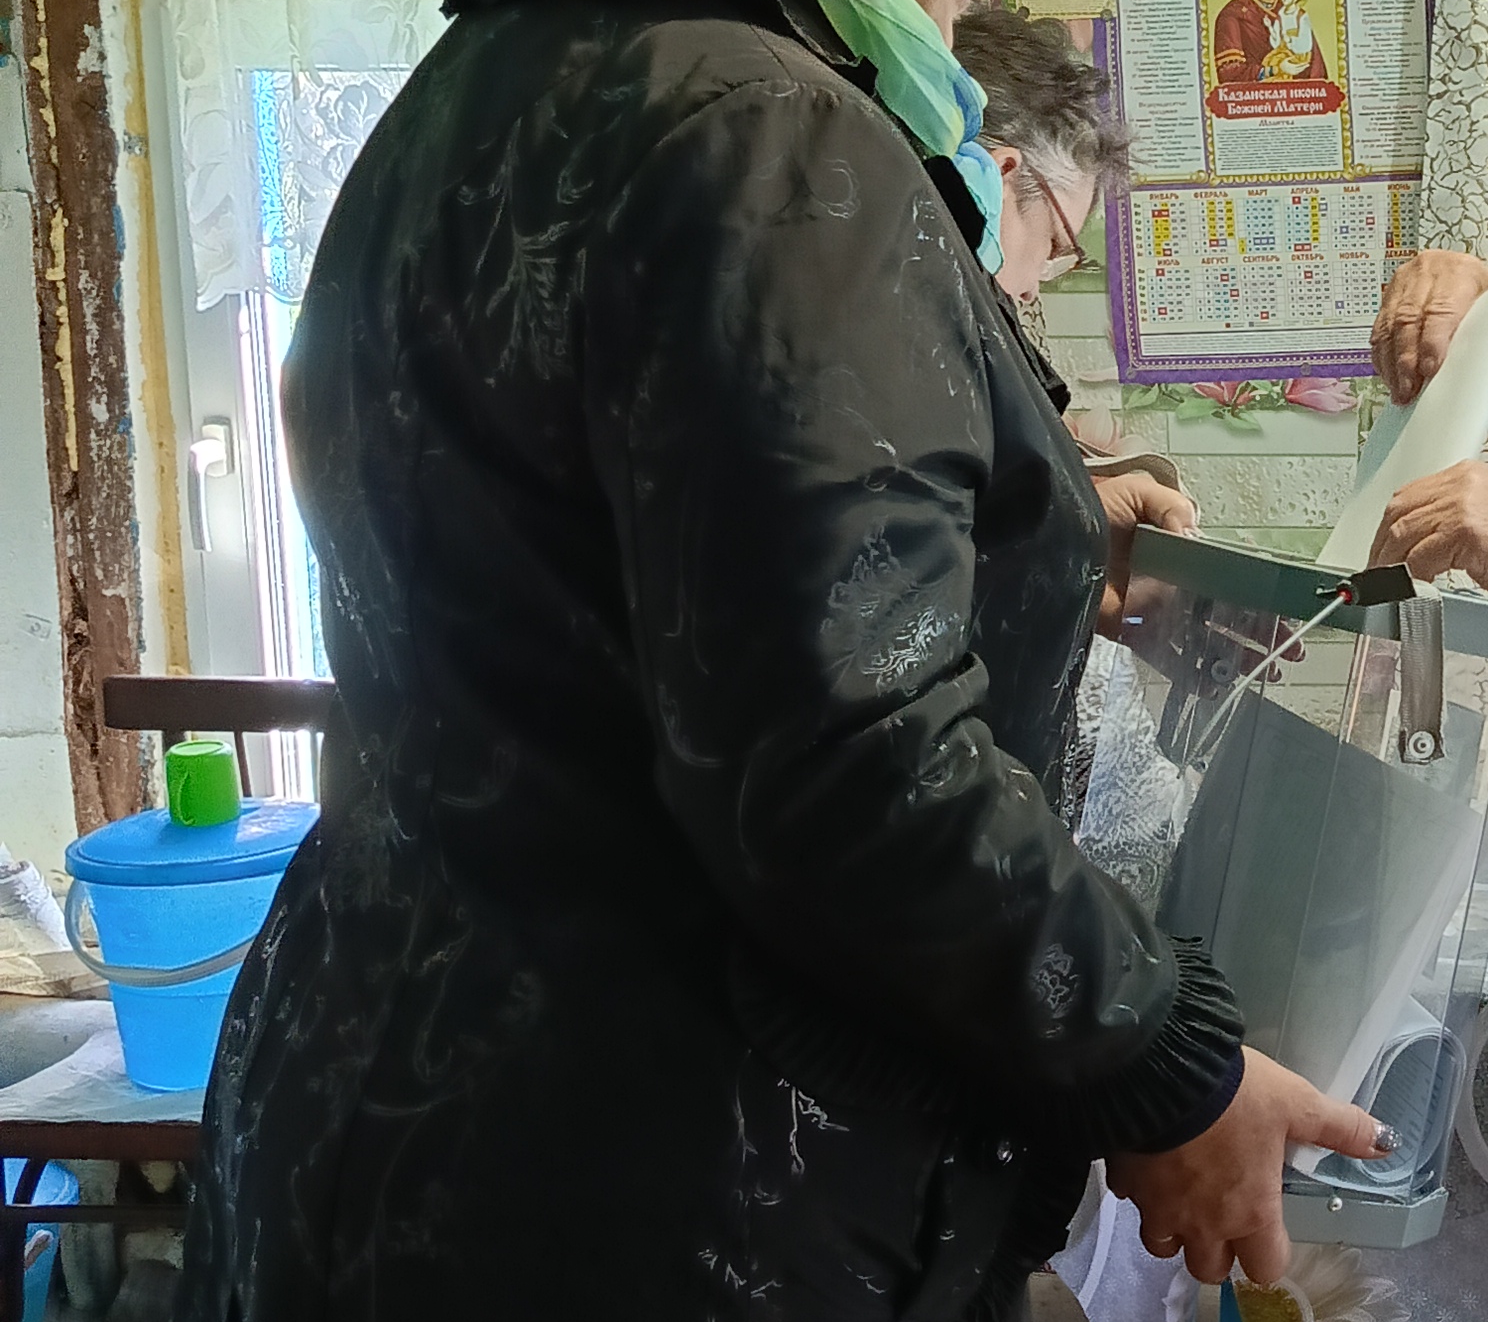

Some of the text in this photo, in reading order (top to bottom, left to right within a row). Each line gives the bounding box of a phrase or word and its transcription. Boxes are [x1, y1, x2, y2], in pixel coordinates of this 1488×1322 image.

[1218, 87, 1327, 101] Казанская икона
[1227, 101, 1324, 115] Божией Матери
[1290, 187, 1319, 195] АПРЕЛЬ
[1343, 185, 1360, 193] МАЙ
[1193, 191, 1228, 199] ФЕВРАЛЬ
[1384, 249, 1418, 258] ДЕКАБРЬ
[1201, 257, 1229, 265] АВГУСТ
[1242, 255, 1280, 263] СЕНТЯБРЬ
